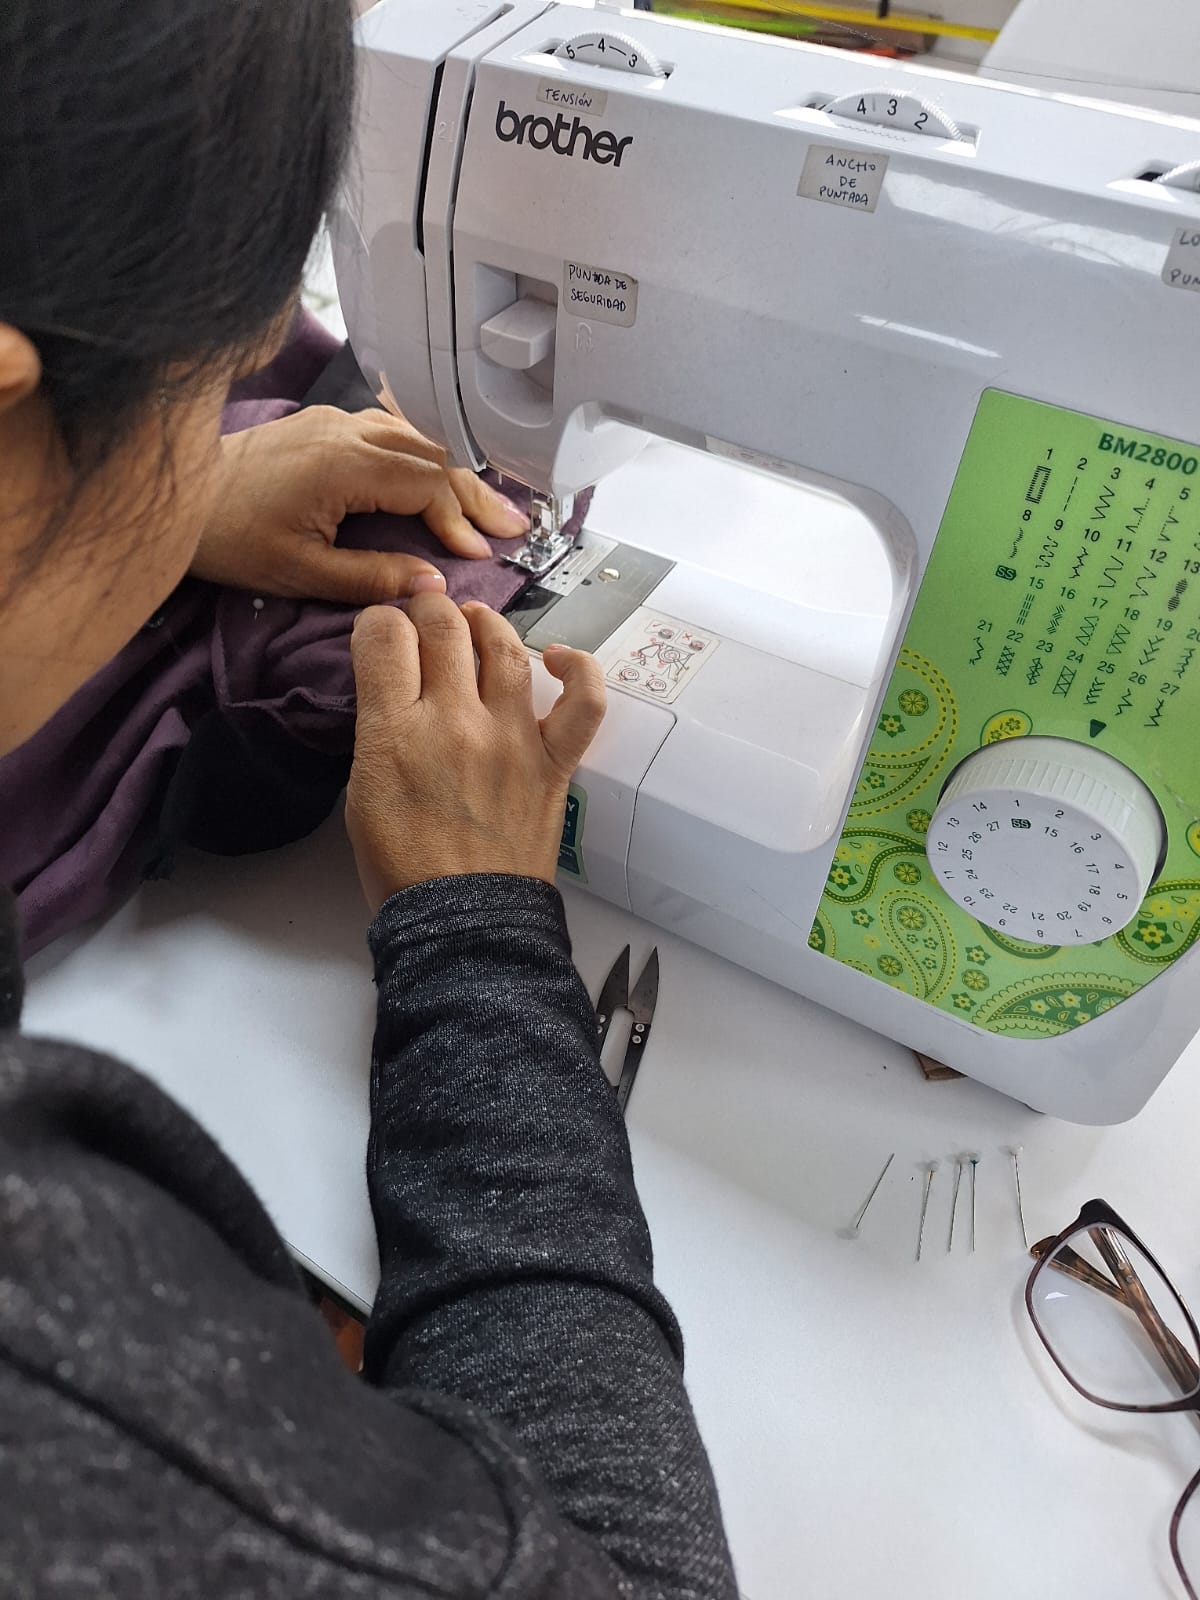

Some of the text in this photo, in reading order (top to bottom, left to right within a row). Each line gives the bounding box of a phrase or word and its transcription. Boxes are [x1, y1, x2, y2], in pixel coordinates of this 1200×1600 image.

[565, 37, 638, 69] 5 4 3
[545, 87, 593, 108] TENSIÓN
[856, 97, 929, 131] 4 3 2
[496, 101, 633, 167] brother
[825, 153, 876, 173] ANCHO
[839, 175, 857, 189] DE
[819, 186, 869, 205] PUNTADA
[614, 278, 628, 290] DE
[570, 288, 627, 312] SEGURIDAD
[1098, 432, 1198, 476] BM2800
[1047, 448, 1191, 501] 1 2 3 4 5
[1022, 509, 1200, 574] 8 9 10 11 12 13
[1029, 576, 1045, 590] 15
[1060, 586, 1076, 600] 16
[1092, 596, 1109, 609] 17
[1123, 607, 1141, 621] 18
[1156, 617, 1174, 632] 19
[976, 619, 1181, 696] 21 22 23 24 25 26 27
[972, 801, 988, 812] 14
[1014, 799, 1020, 807] 1
[1054, 809, 1065, 819] 2
[946, 817, 960, 828] 13
[986, 820, 1000, 832] 27
[968, 831, 982, 844] 26
[1044, 826, 1058, 838] 15
[1090, 832, 1102, 841] 3
[937, 841, 949, 852] 12
[1069, 841, 1085, 854] 16
[961, 848, 973, 861] 25
[966, 869, 979, 880] 24
[1085, 863, 1100, 874] 17
[943, 870, 955, 880] 11
[978, 887, 995, 900] 23
[1088, 884, 1101, 896] 18
[1116, 892, 1128, 900] 5
[963, 895, 976, 907] 10
[1077, 901, 1092, 912] 19
[1002, 902, 1019, 914] 22
[1031, 911, 1045, 921] 21
[1056, 910, 1072, 921] 20
[1101, 916, 1113, 925] 6
[998, 918, 1007, 926] 9
[1036, 929, 1044, 938] 8
[1074, 928, 1083, 938] 7
